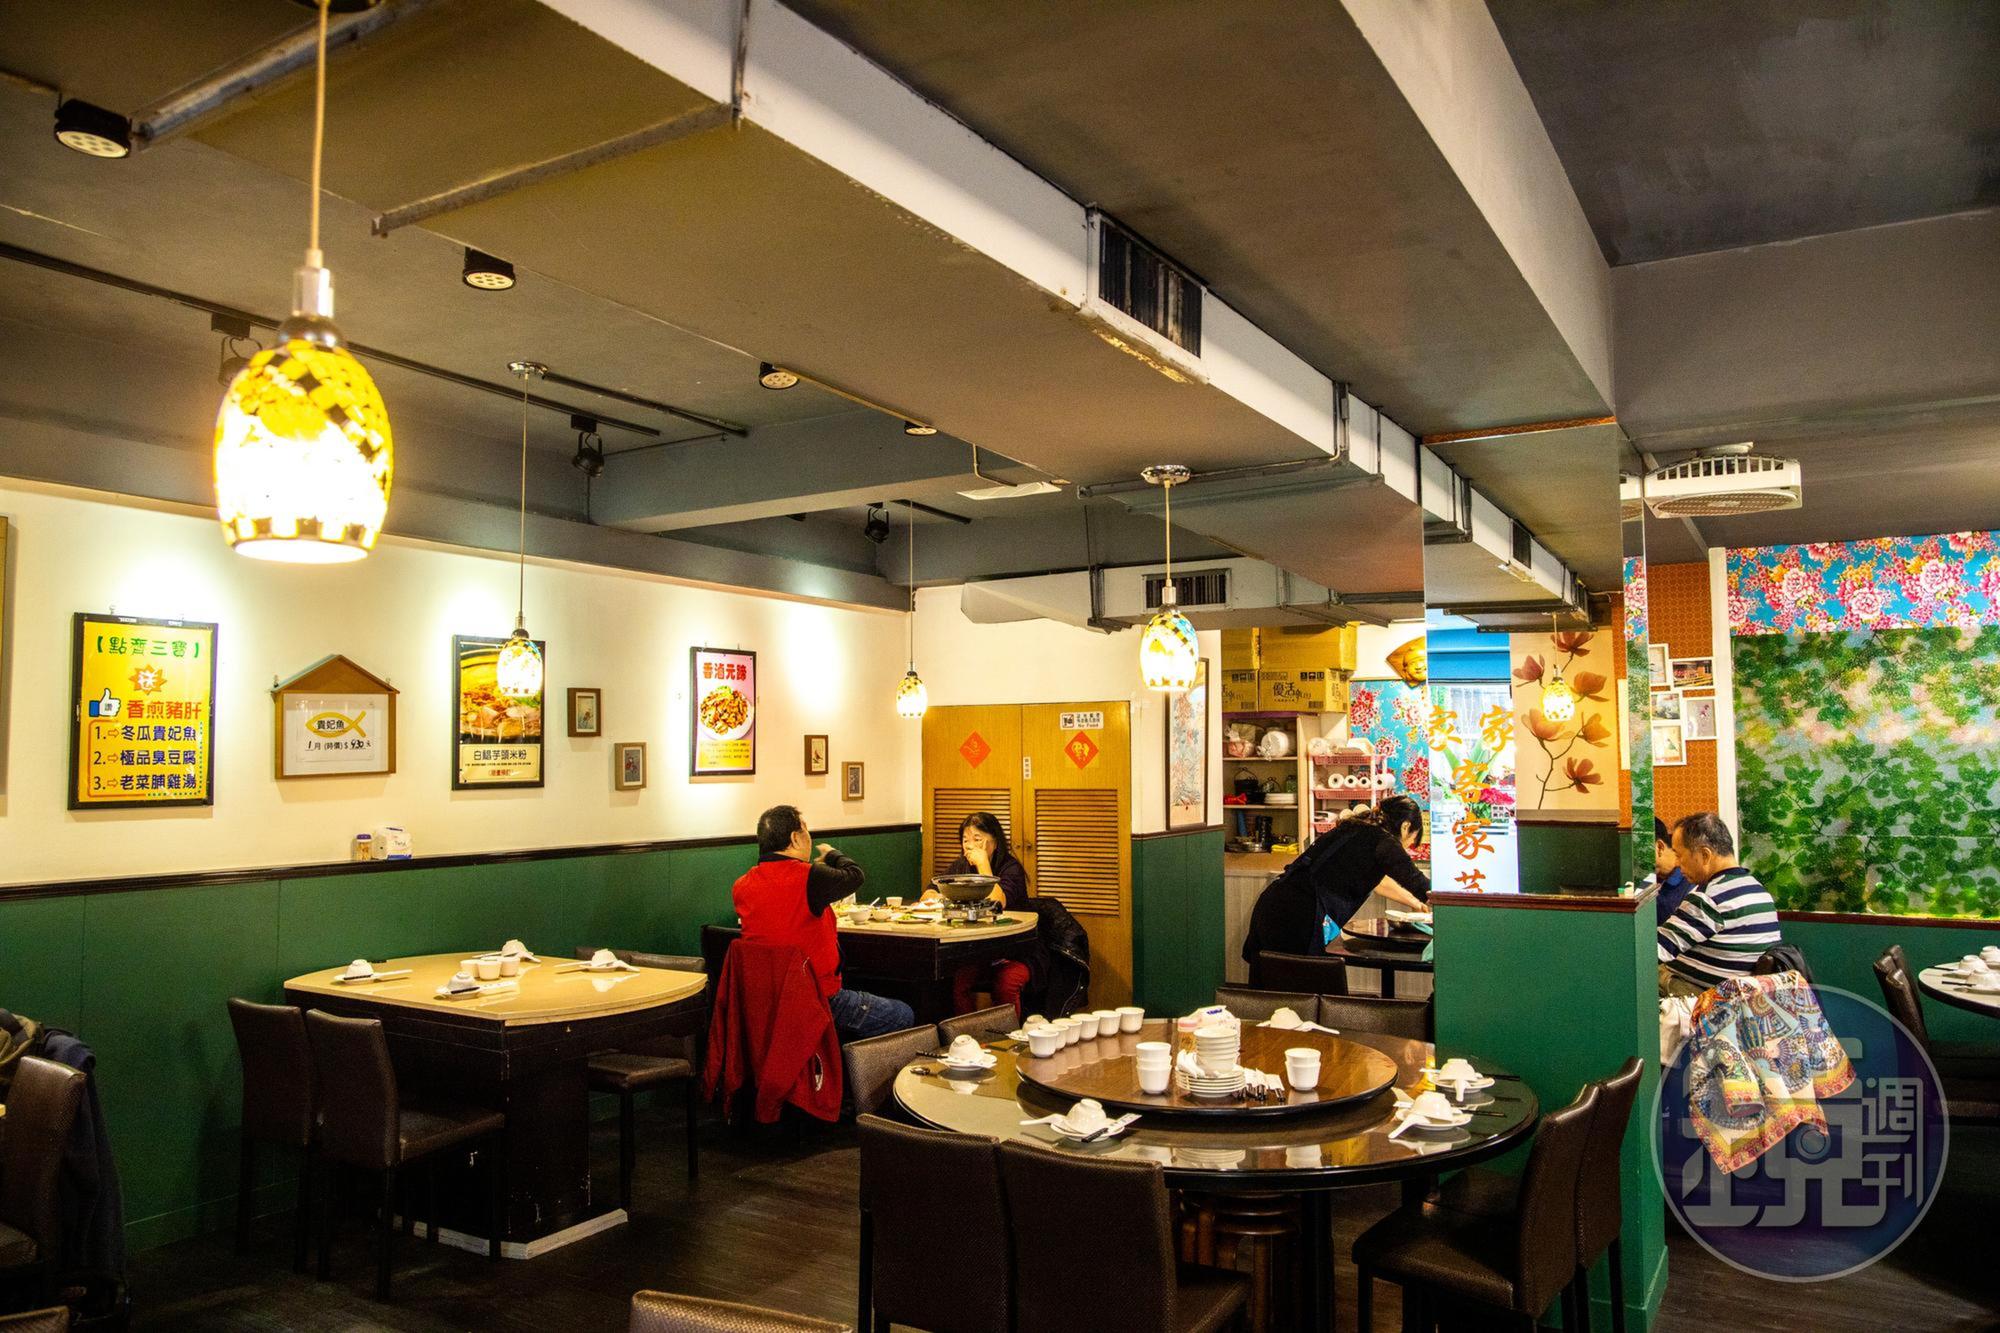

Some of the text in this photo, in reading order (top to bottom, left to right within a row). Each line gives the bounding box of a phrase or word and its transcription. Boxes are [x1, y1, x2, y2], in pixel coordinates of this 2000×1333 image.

[127, 700, 202, 719] 香煎豬肝
[121, 725, 197, 741] 冬瓜貴妃魚
[316, 719, 345, 730] 貴妃魚
[120, 749, 196, 766] 極品臭豆腐
[120, 774, 196, 791] 老菜脯雞湯
